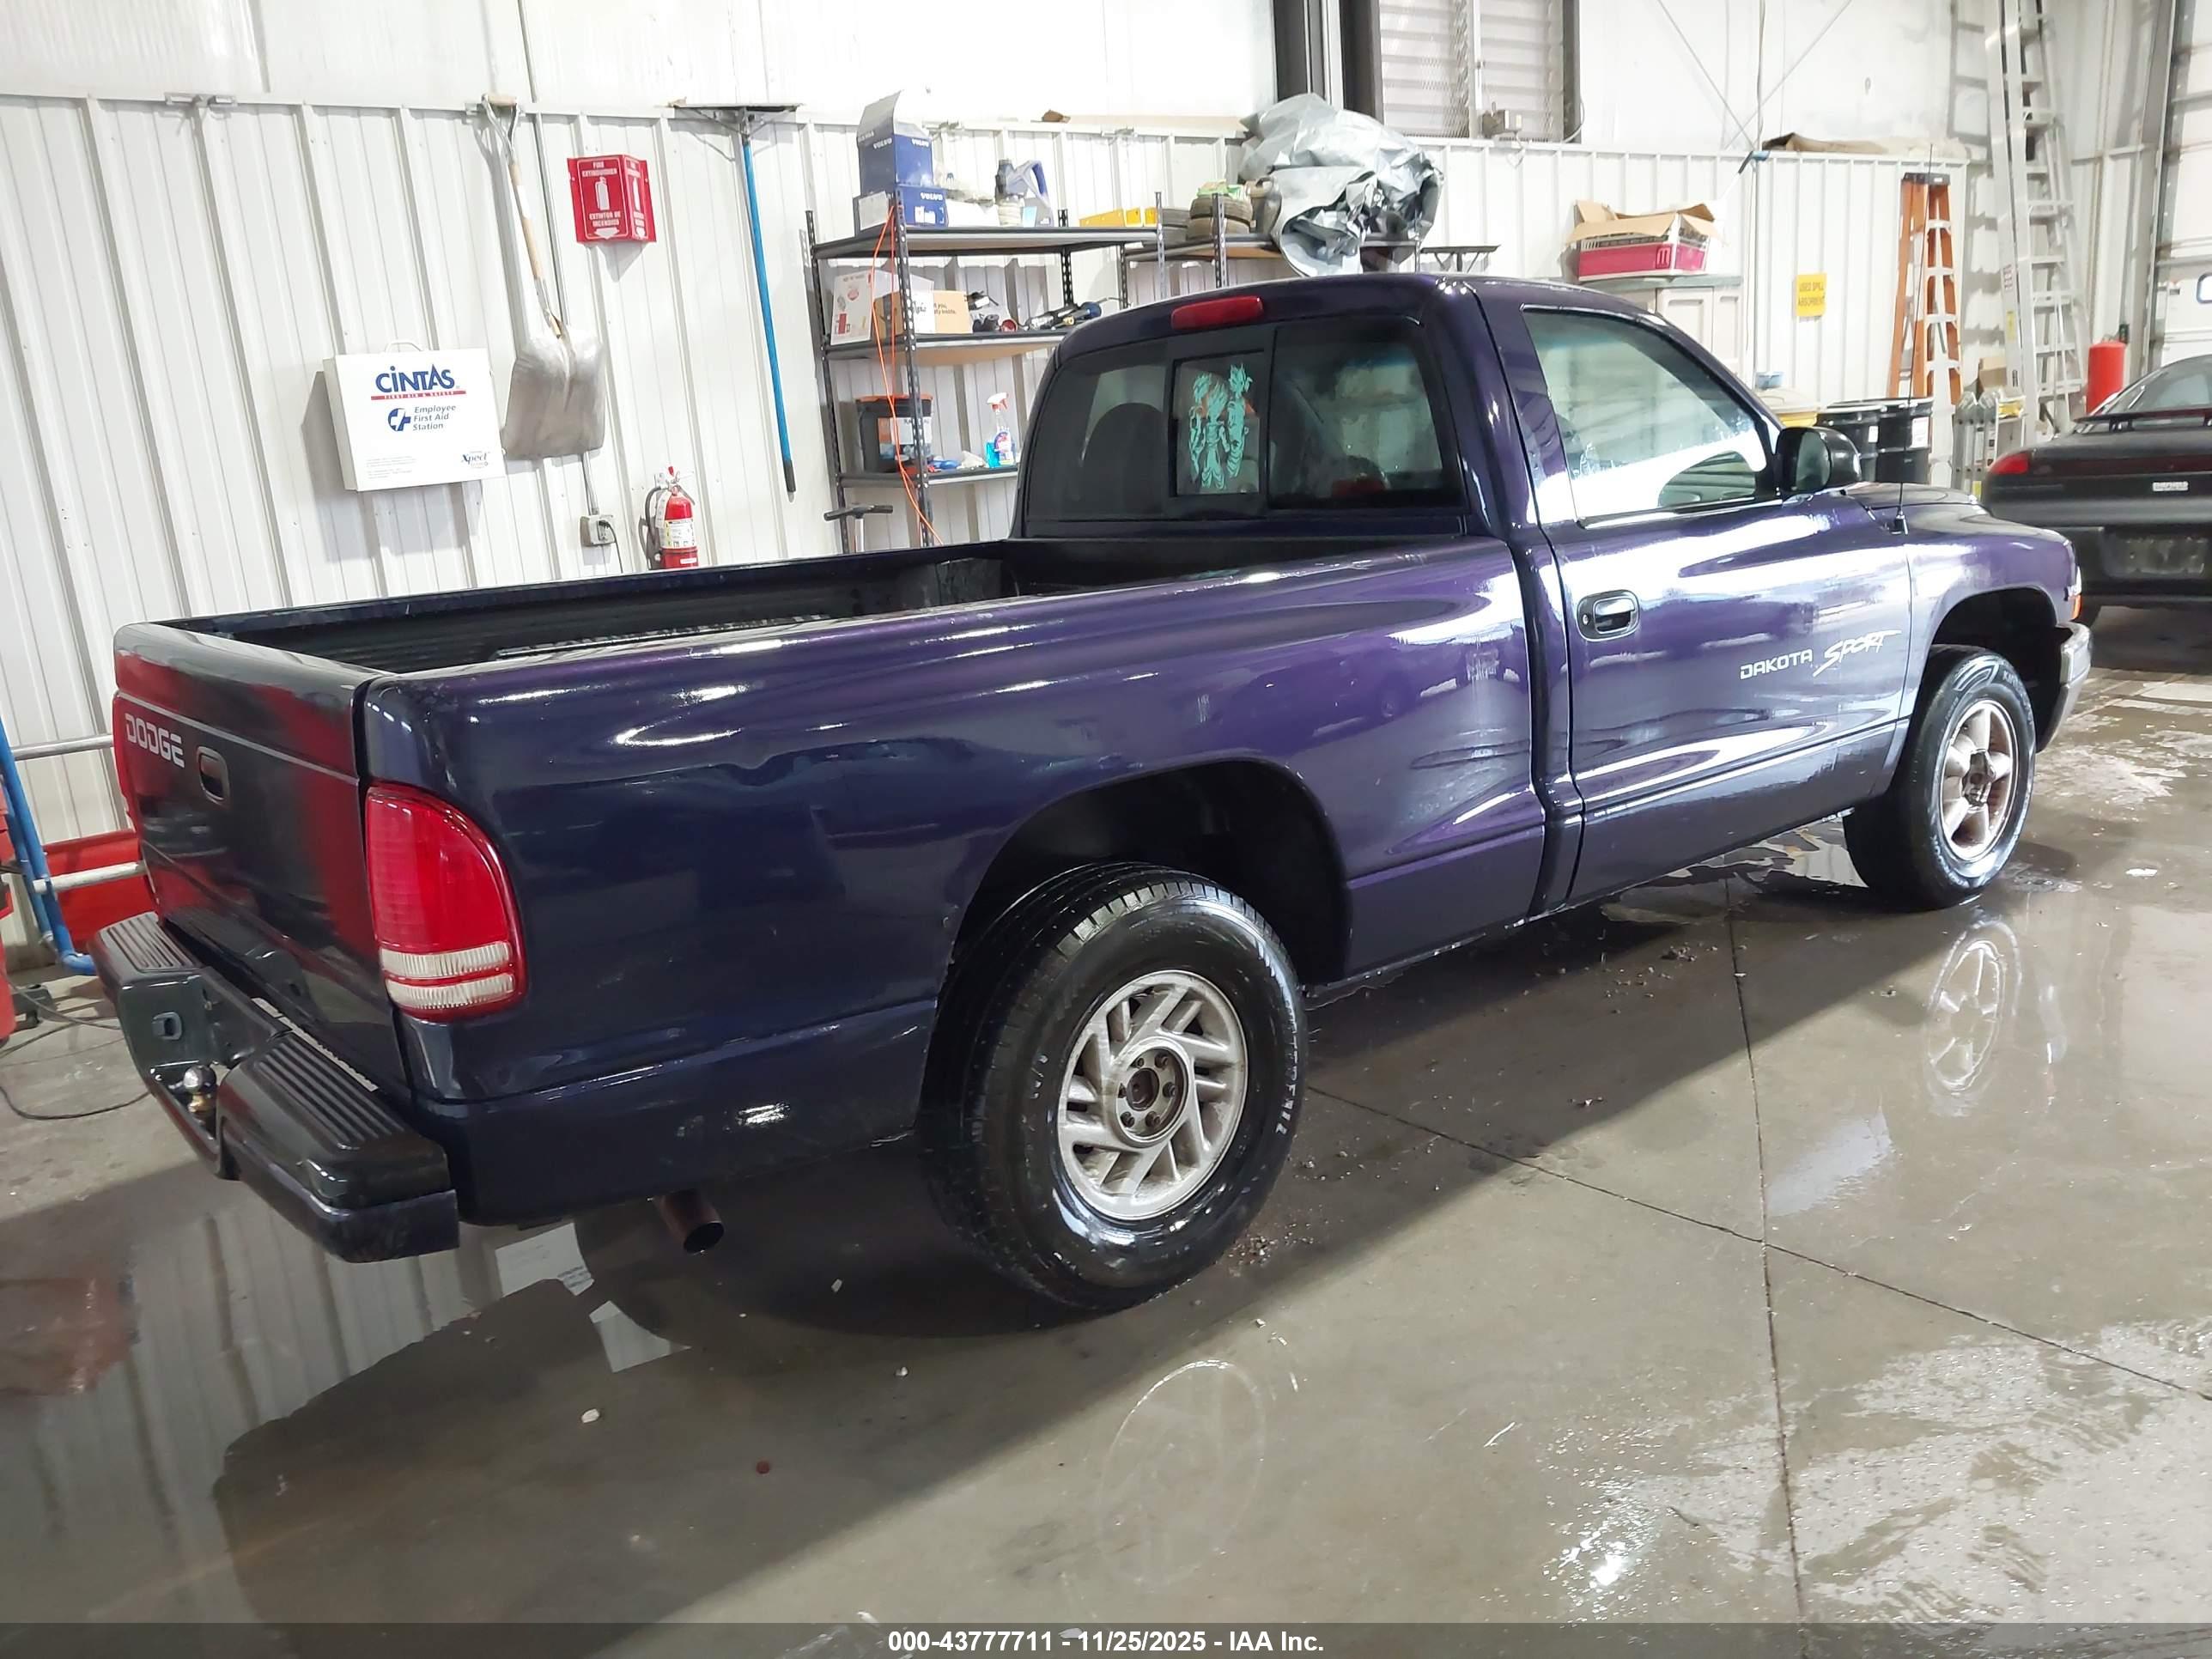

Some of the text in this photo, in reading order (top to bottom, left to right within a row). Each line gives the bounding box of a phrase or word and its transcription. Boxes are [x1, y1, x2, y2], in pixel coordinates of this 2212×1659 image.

[911, 138, 930, 147] VOLVO
[920, 191, 943, 201] VOLVO
[375, 363, 455, 392] CINTAS
[414, 404, 457, 415] Employee
[414, 414, 432, 422] First
[412, 422, 444, 431] Station
[1740, 629, 1902, 680] DAKOTA SPORT
[125, 713, 185, 769] DODGE
